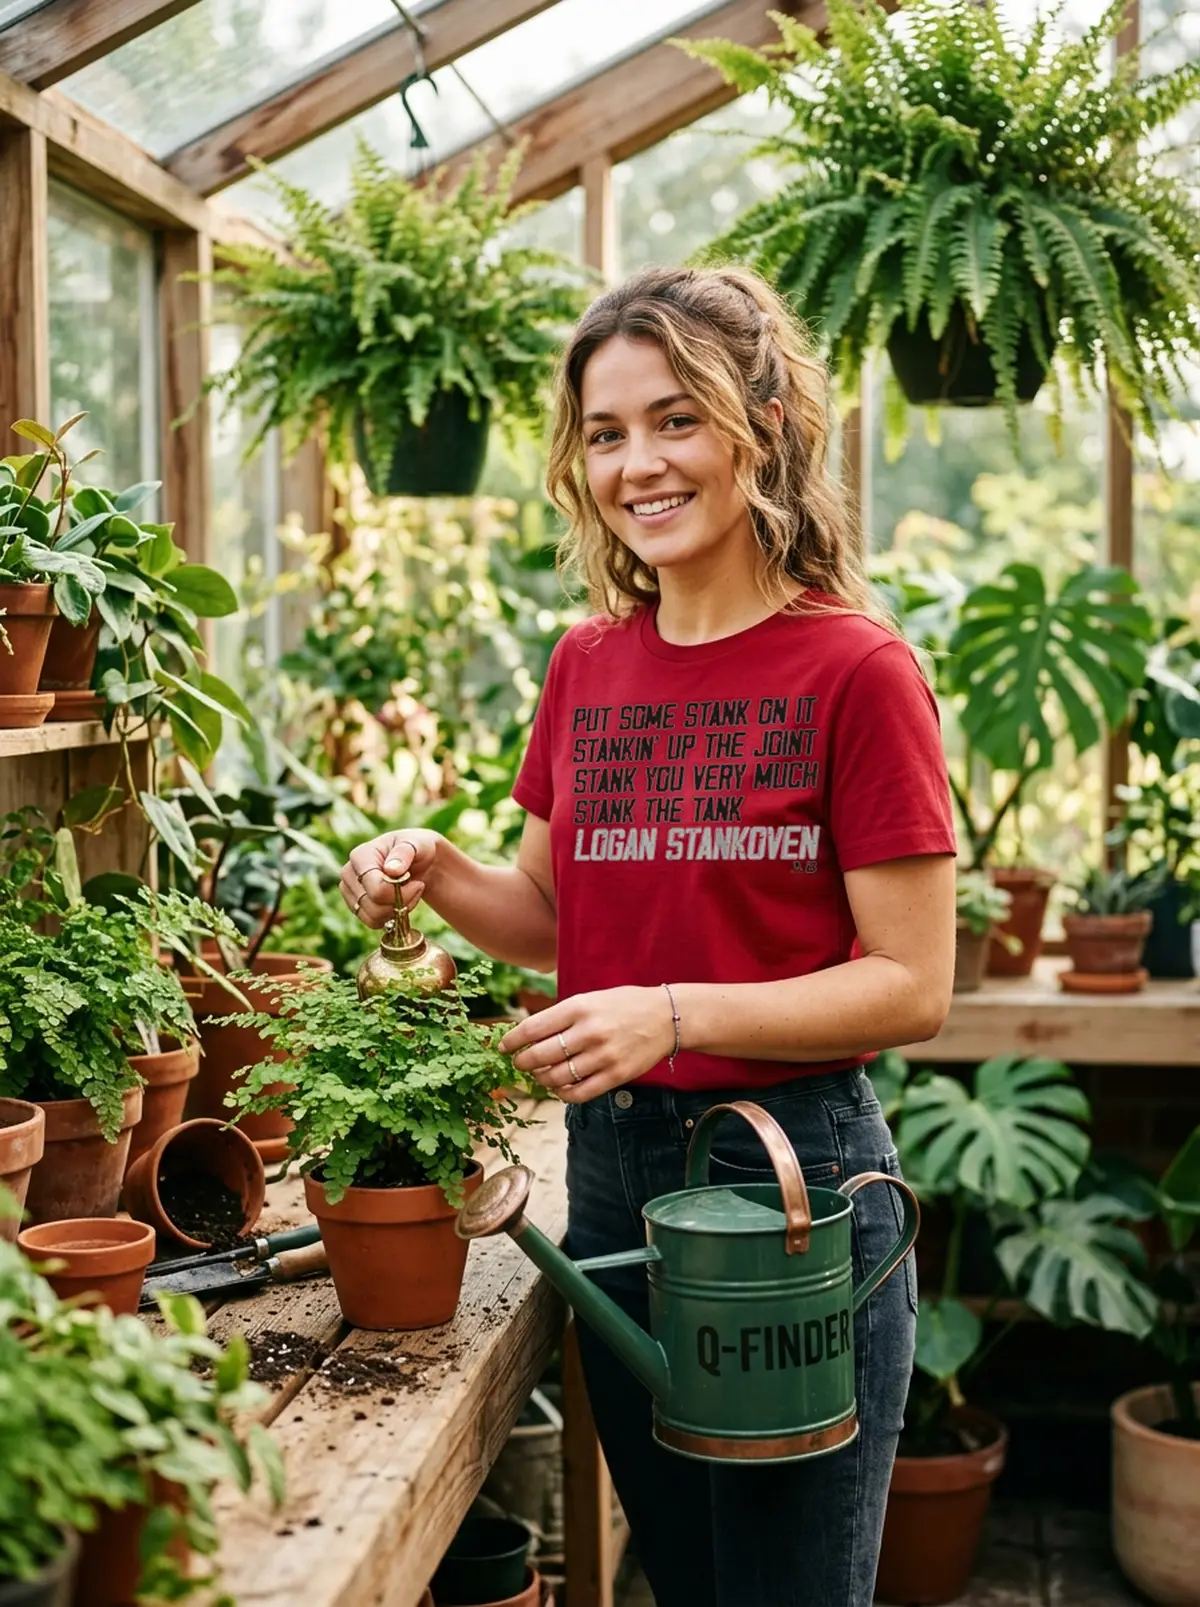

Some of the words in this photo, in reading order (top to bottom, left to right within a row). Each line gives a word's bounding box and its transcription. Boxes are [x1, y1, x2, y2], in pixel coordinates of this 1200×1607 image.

[572, 707, 612, 732] PUT
[619, 703, 677, 730] SOME
[684, 700, 750, 728] STANK
[758, 698, 788, 725] ON
[796, 696, 818, 724] IT
[667, 734, 696, 760] UP
[704, 732, 746, 758] THE
[753, 729, 818, 757] JOINT
[573, 767, 637, 793] STANK
[646, 766, 685, 792] YOU
[693, 764, 746, 791] VERY
[753, 762, 819, 789] MUCH
[574, 799, 636, 824] STANK
[645, 797, 684, 822] THE
[692, 796, 744, 822] TANK
[574, 828, 657, 861] LOGAN
[665, 825, 820, 860] STANKOVEN
[697, 1308, 850, 1377] Q-FINDER
